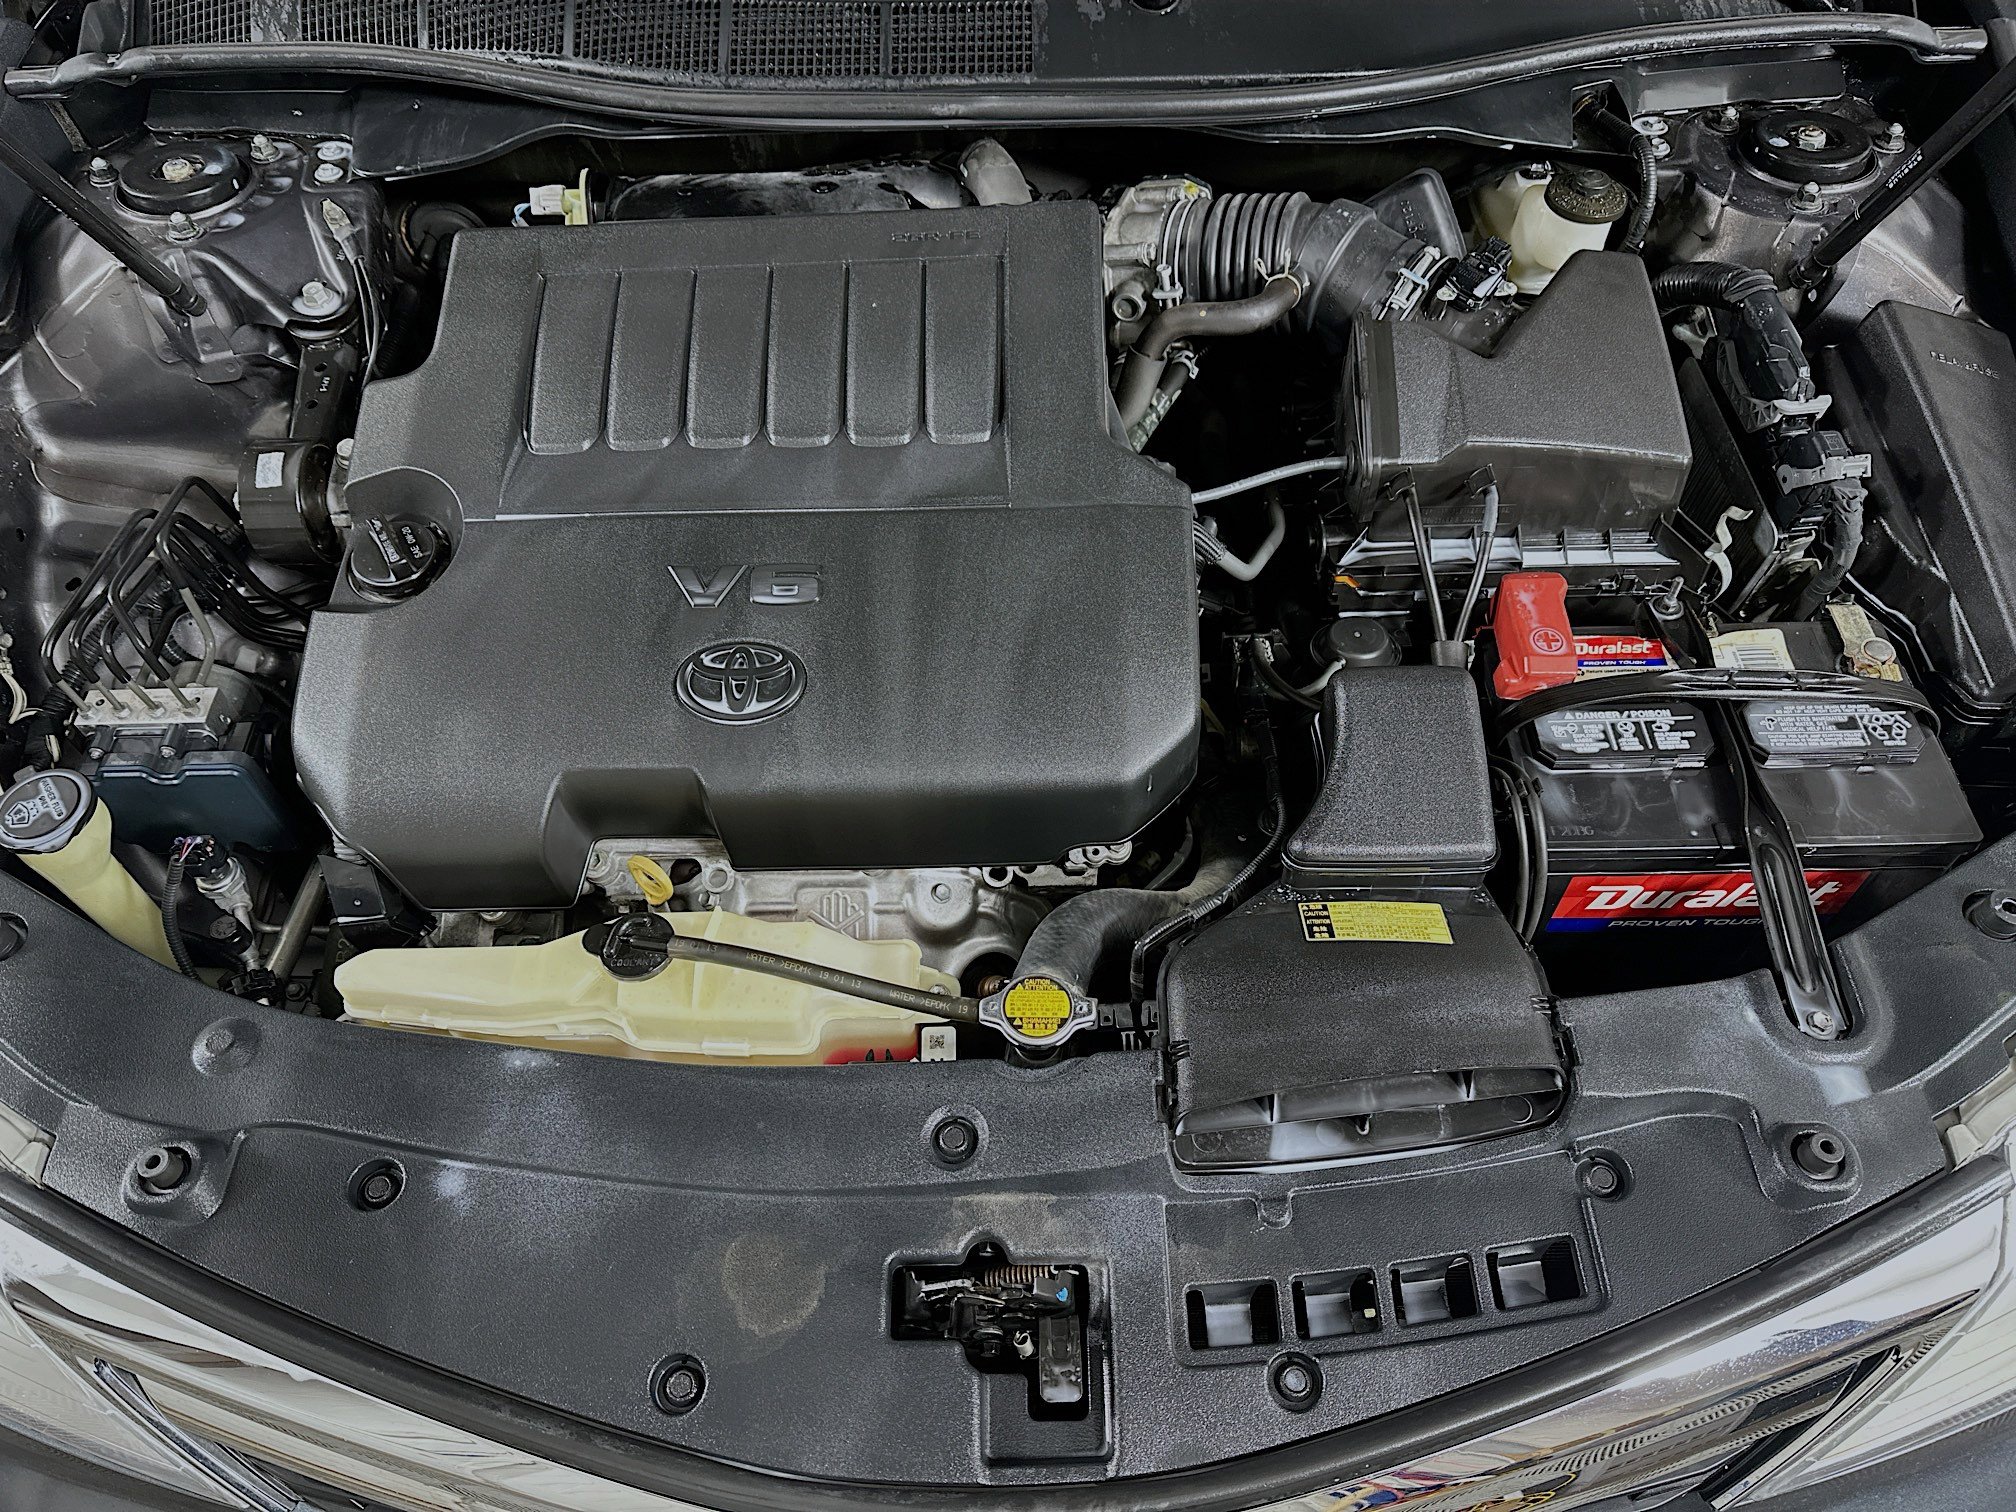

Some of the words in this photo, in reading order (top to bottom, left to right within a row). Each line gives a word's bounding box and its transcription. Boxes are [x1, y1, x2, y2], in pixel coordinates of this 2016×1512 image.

[410, 545, 423, 559] SAE
[667, 564, 820, 609] V6
[1574, 641, 1654, 655] Duralast
[1574, 711, 1621, 720] DANGER
[1630, 708, 1672, 718] POISON
[41, 779, 57, 802] WASHER
[52, 801, 64, 818] FLUID
[1584, 881, 1842, 910] Duralat
[1608, 919, 1696, 928] PROVEN
[1703, 918, 1764, 926] TOUG
[611, 958, 656, 967] COOLANT
[706, 944, 718, 953] 13
[746, 952, 776, 966] WATER
[819, 970, 830, 980] 19
[833, 974, 845, 984] 01
[851, 980, 862, 989] 13
[889, 989, 916, 1004] WATER
[958, 1005, 969, 1014] 19
